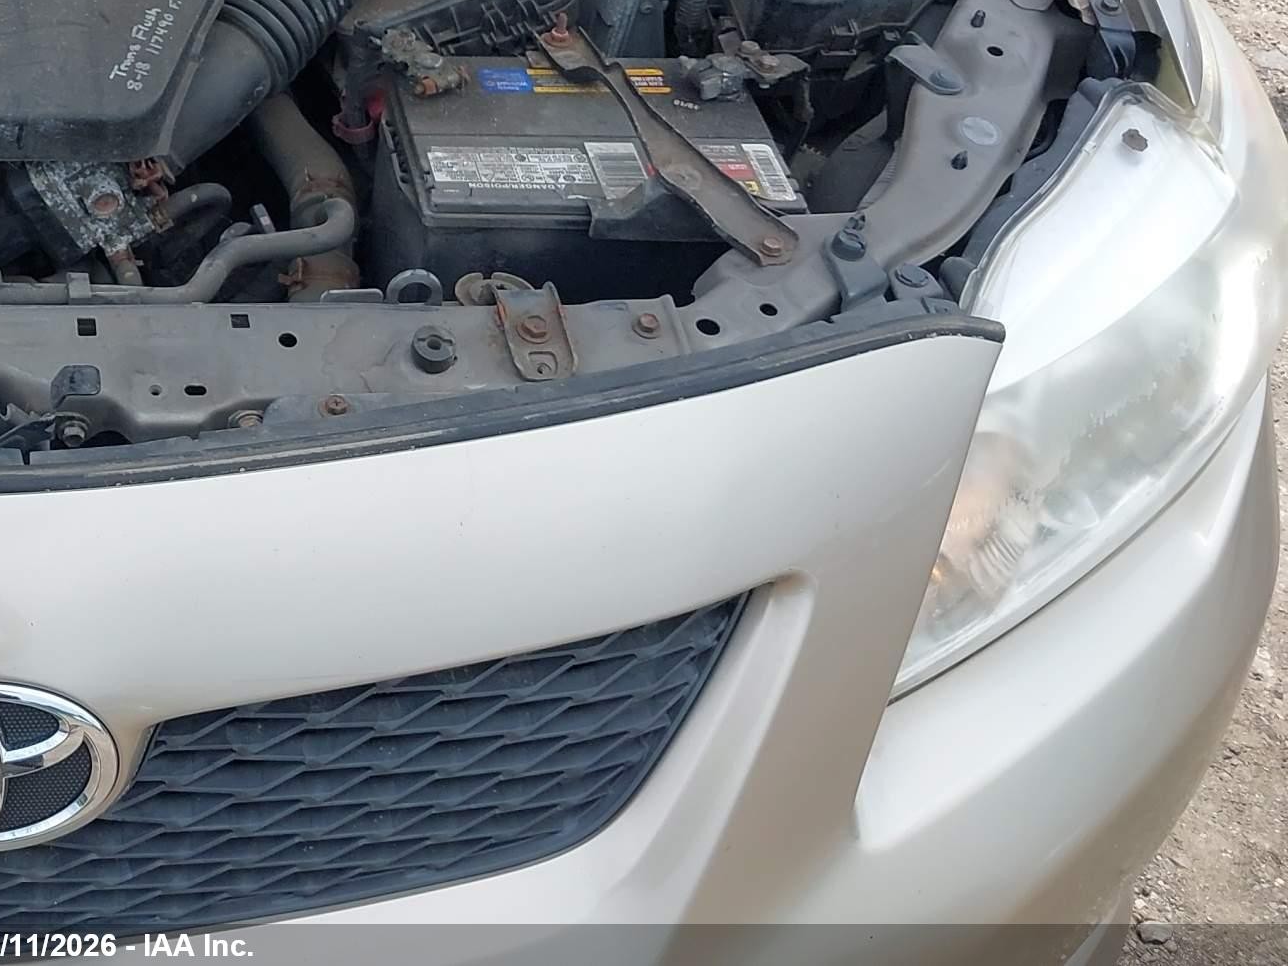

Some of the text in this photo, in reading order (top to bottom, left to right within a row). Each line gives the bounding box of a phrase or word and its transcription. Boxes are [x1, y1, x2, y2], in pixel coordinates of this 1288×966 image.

[127, 61, 151, 91] 8-18
[145, 13, 175, 55] 117490
[132, 8, 162, 41] Flush
